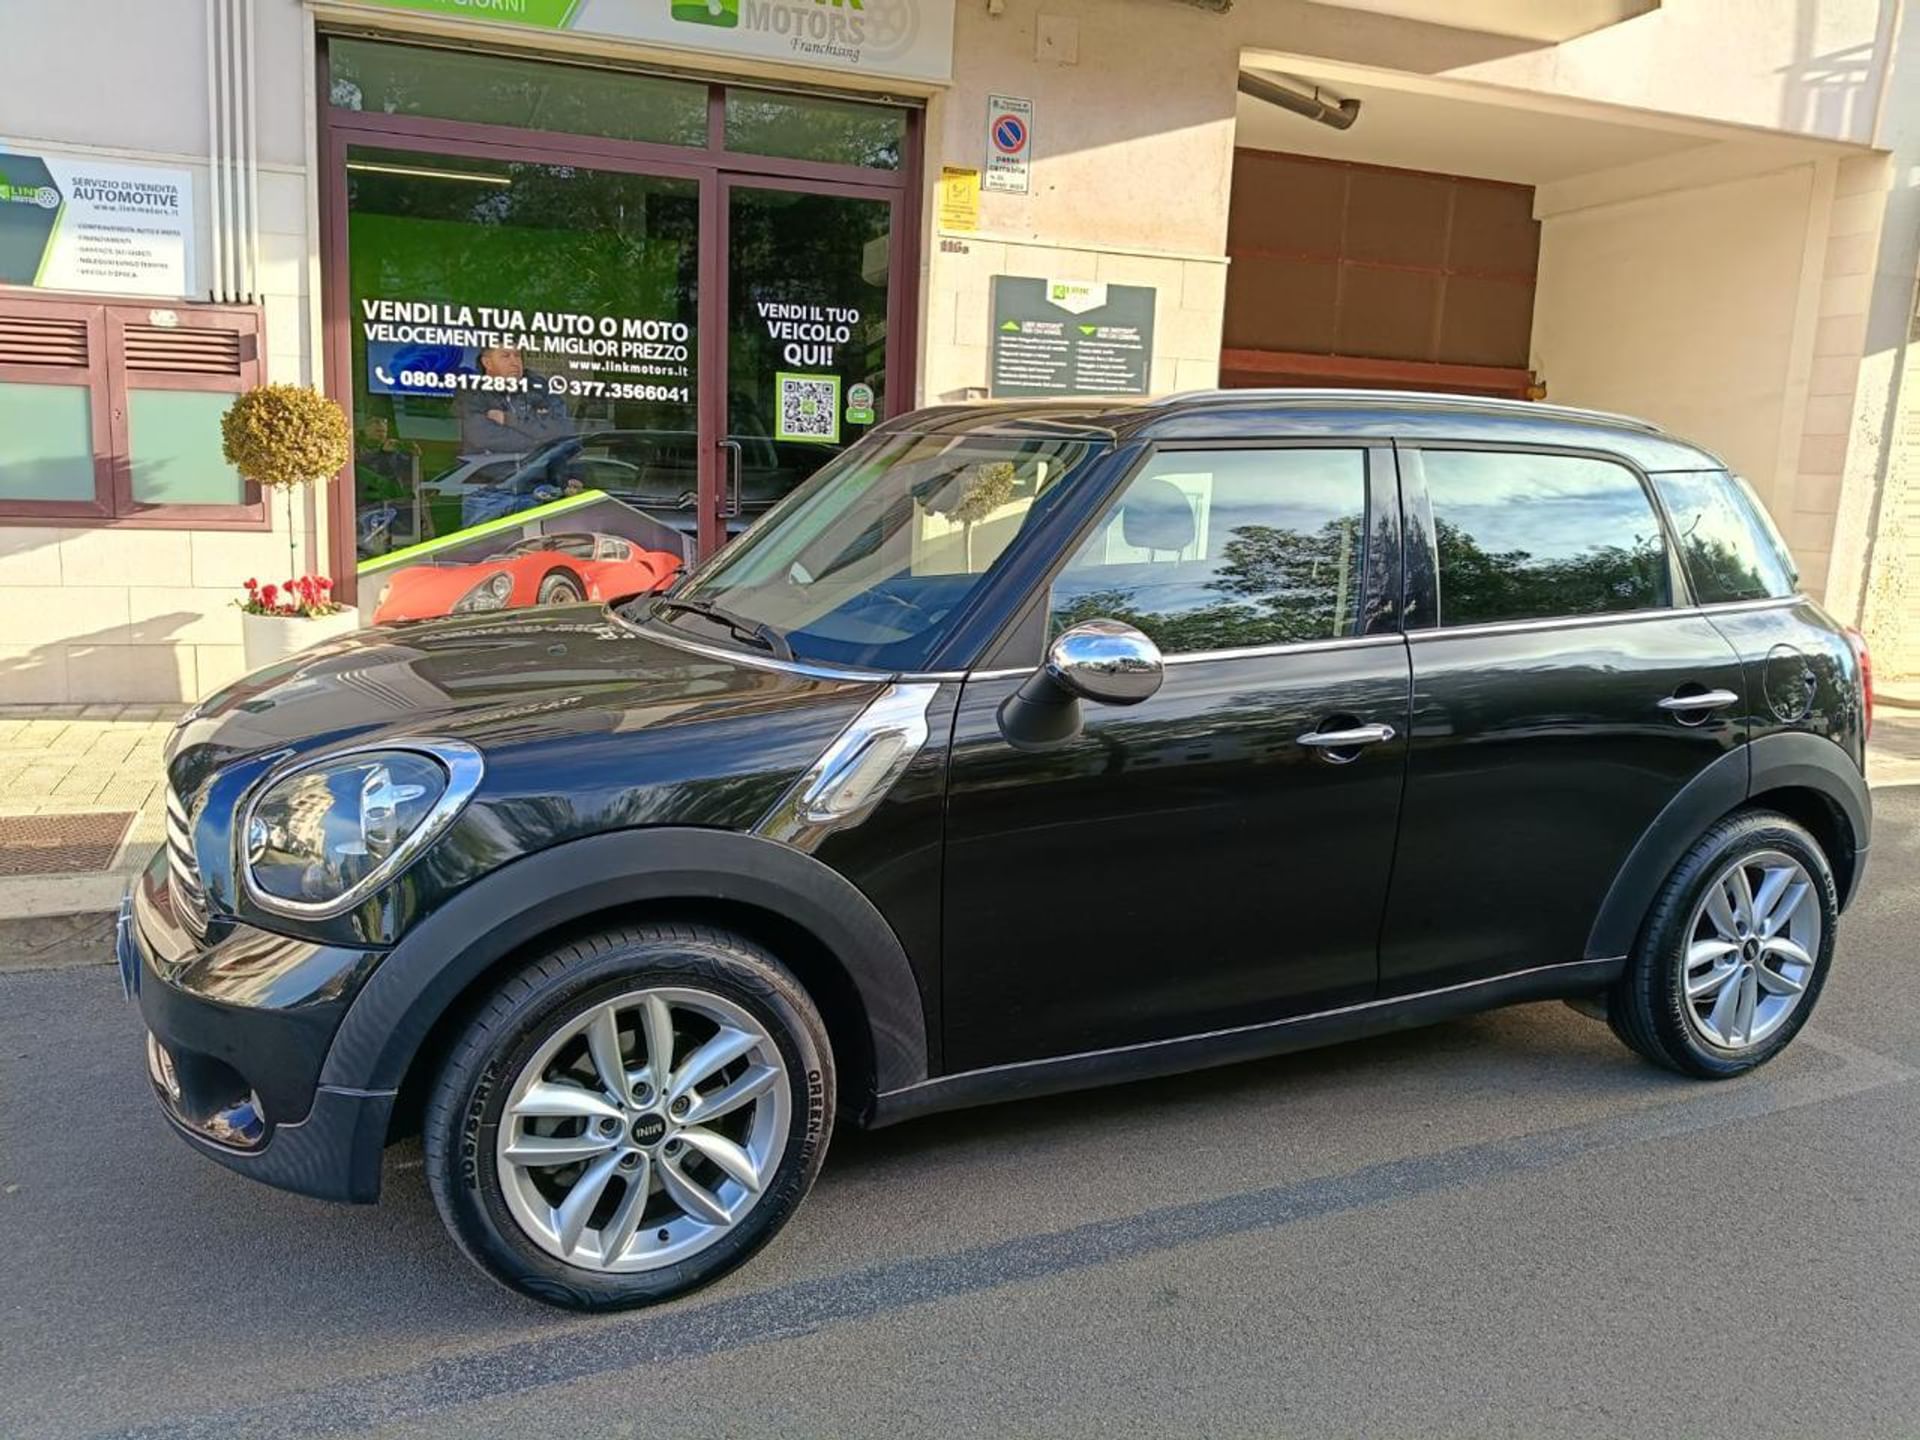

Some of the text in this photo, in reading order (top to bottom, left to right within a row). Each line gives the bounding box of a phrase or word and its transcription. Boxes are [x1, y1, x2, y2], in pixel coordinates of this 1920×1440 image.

[745, 2, 865, 46] MOTORS
[790, 37, 861, 63] Franchising
[72, 177, 178, 194] SERVIZIO DI VENDITA
[73, 187, 178, 208] AUTOMOTIVE
[362, 299, 689, 342] VENDI LA TUA AUTO O MOTO
[757, 301, 860, 324] VENDI IL TUO
[363, 323, 689, 362] VELOCEMENTE E AL MIGLIOR PREZZO
[767, 320, 850, 343] VEICOLO
[784, 343, 833, 366] QUI!
[569, 359, 688, 377] www.linkmotors.it
[400, 370, 528, 393] 080.8172831
[569, 379, 689, 403] 377.3566041
[636, 1122, 662, 1138] MINI
